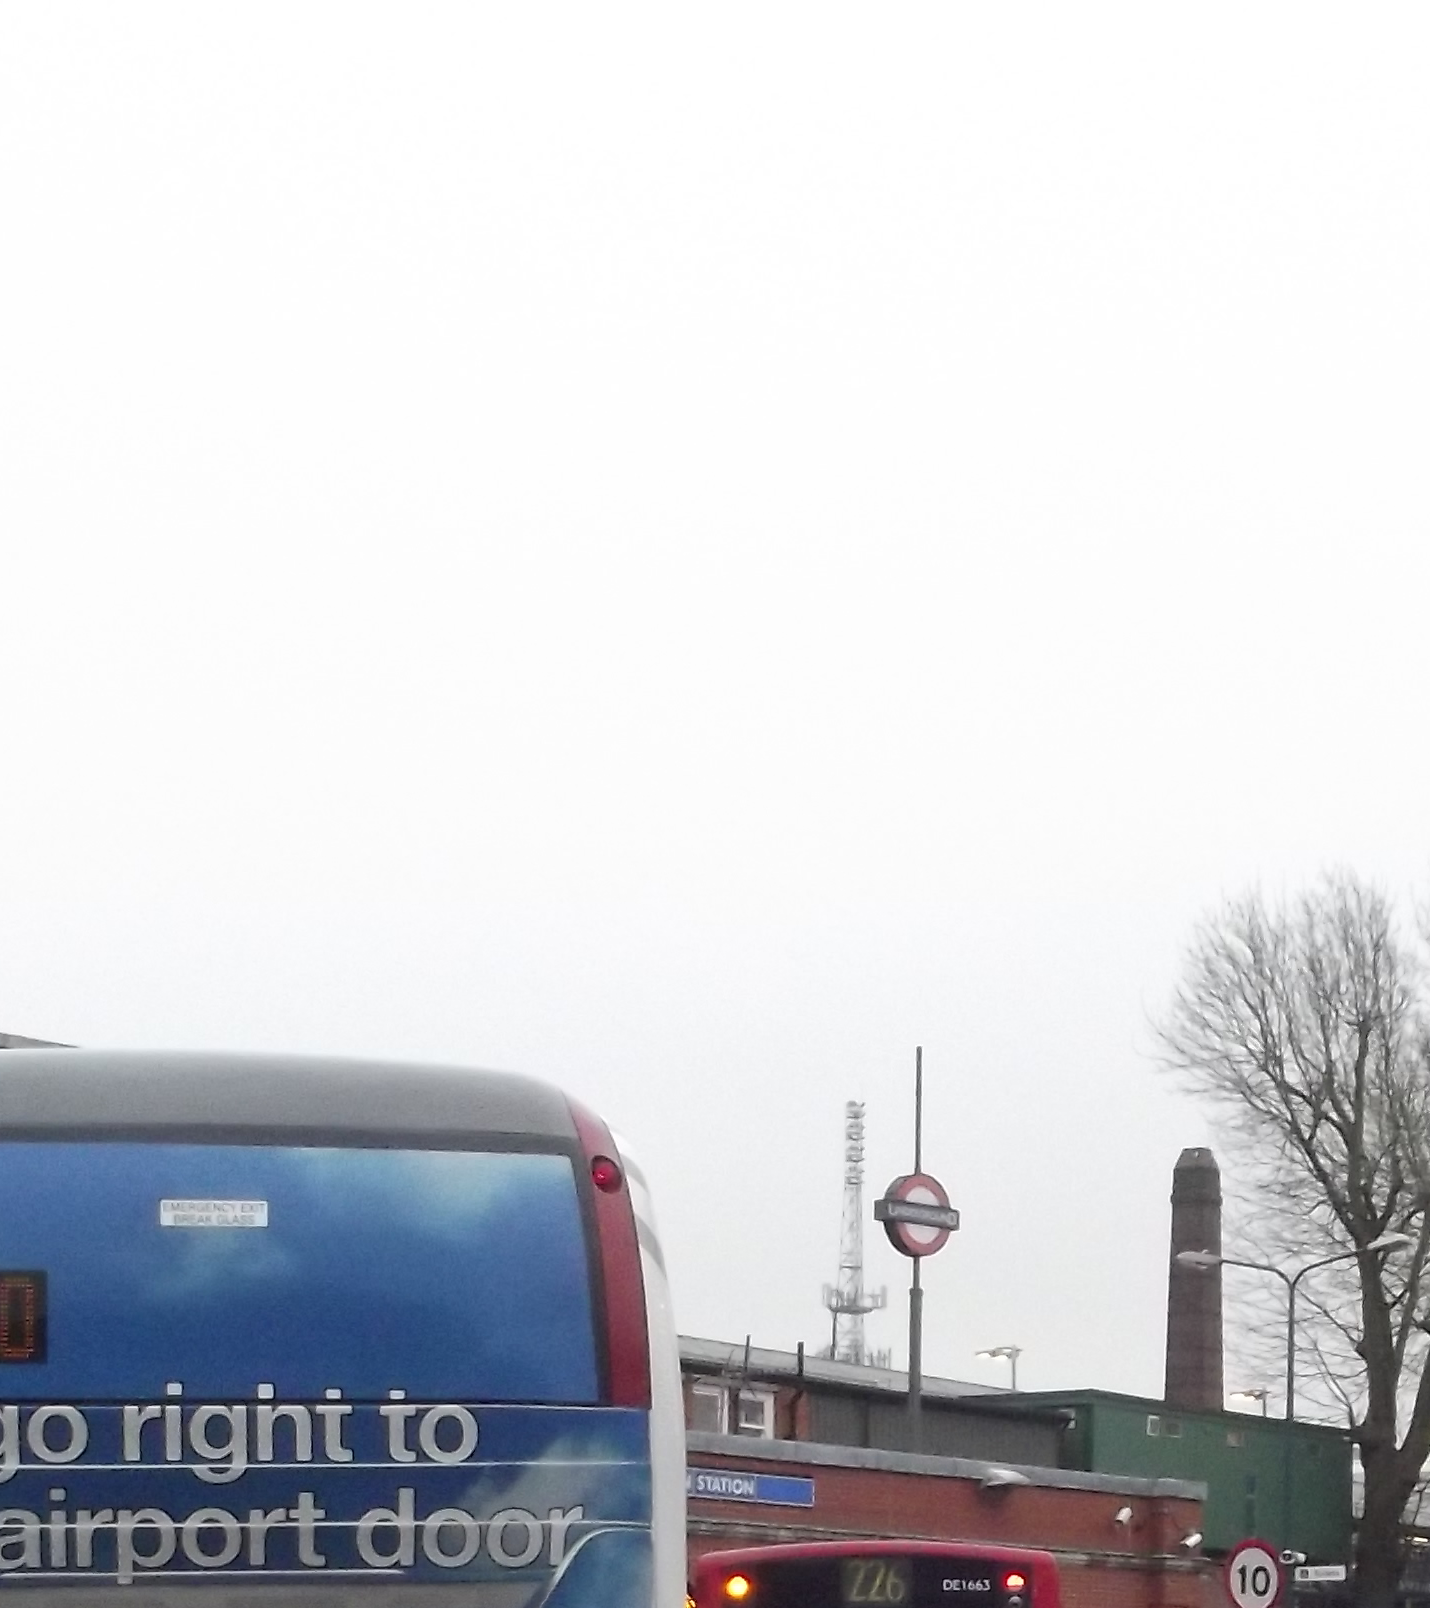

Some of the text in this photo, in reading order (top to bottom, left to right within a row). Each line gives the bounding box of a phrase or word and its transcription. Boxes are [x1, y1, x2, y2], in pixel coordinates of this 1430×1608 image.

[163, 1203, 266, 1213] EMERGENCY EXIT
[174, 1214, 255, 1225] BREAK GLASS
[122, 1382, 353, 1484] right
[379, 1389, 479, 1463] to
[696, 1475, 755, 1495] STATION
[356, 1487, 583, 1568] door
[847, 1560, 906, 1603] 226
[942, 1579, 991, 1591] DE1663
[1237, 1564, 1271, 1597] 10
